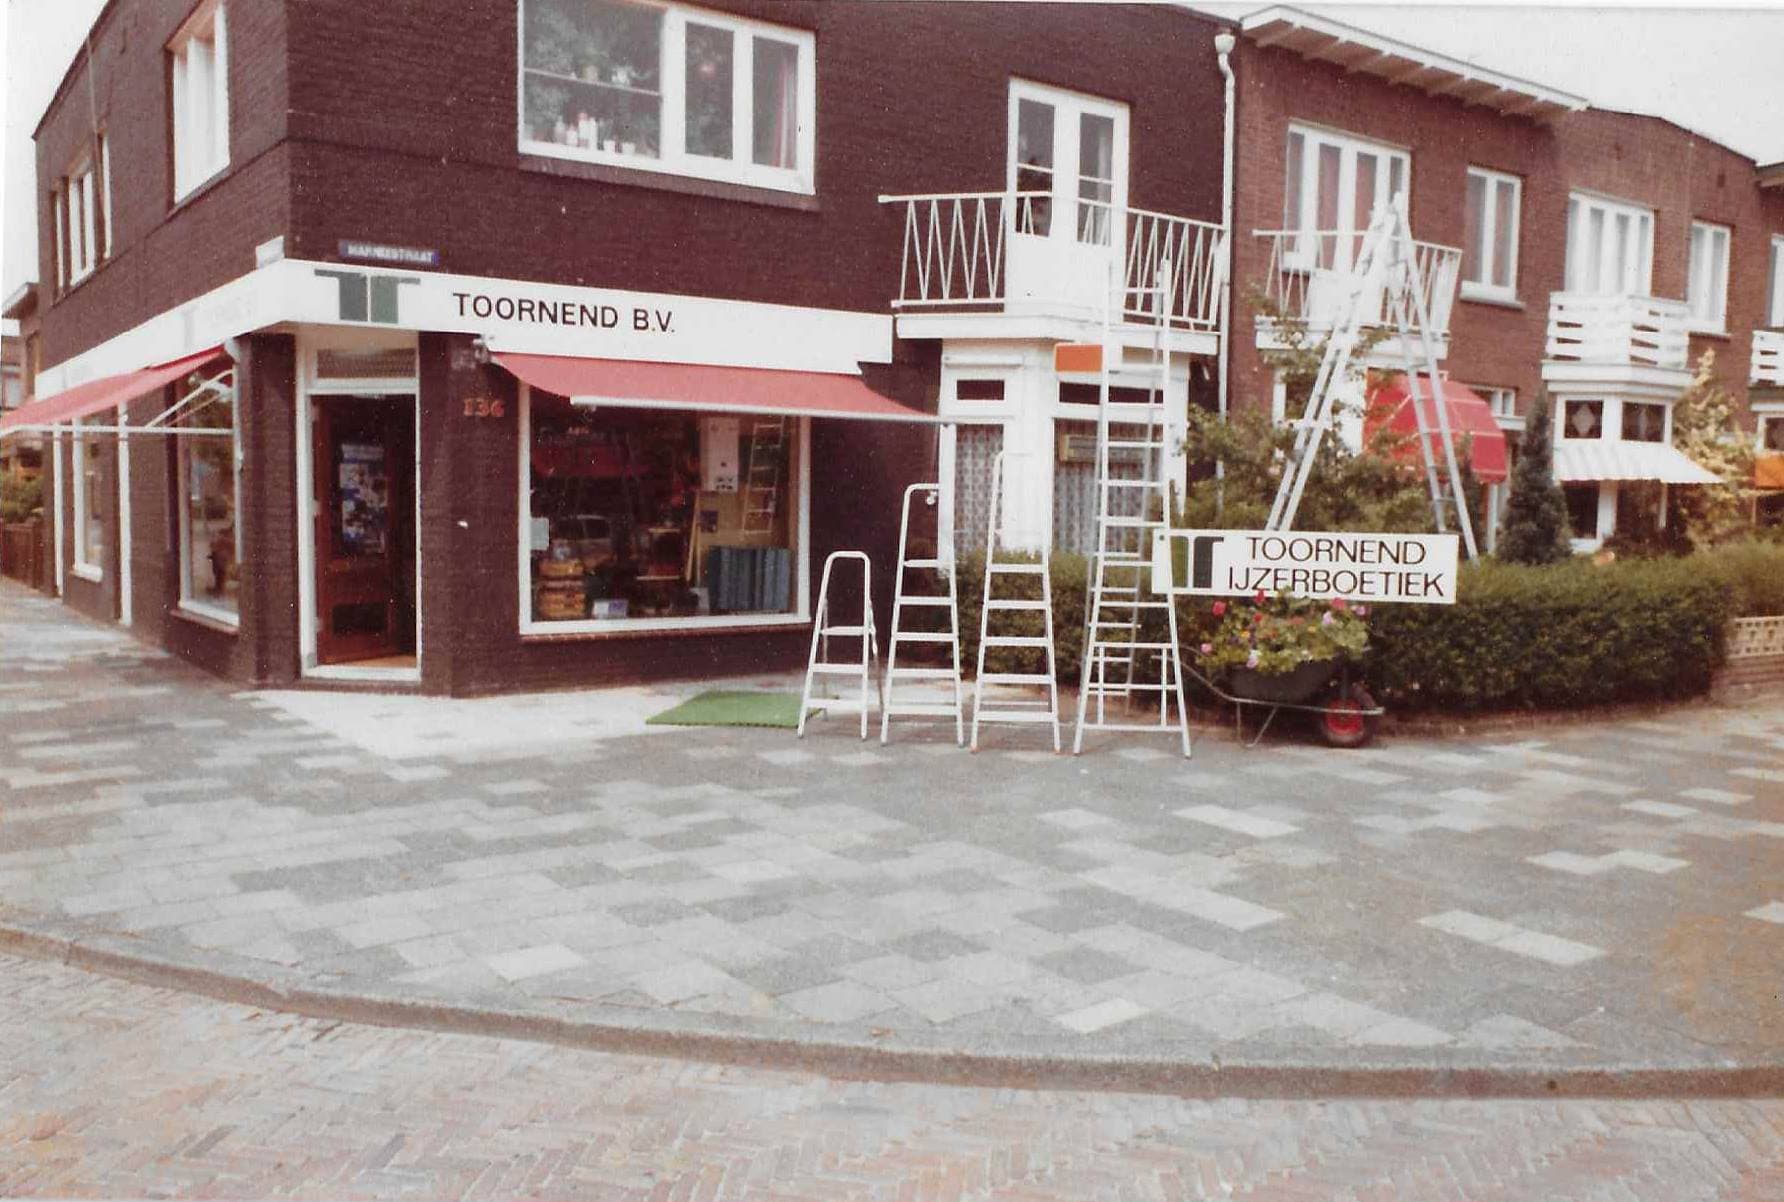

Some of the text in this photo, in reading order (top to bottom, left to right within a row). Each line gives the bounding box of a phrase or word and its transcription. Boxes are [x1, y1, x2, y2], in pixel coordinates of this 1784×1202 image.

[453, 292, 676, 333] TOORNEND B.V.
[1247, 536, 1427, 565] TOORNEND
[1228, 566, 1445, 598] IJZERBOETIEK
